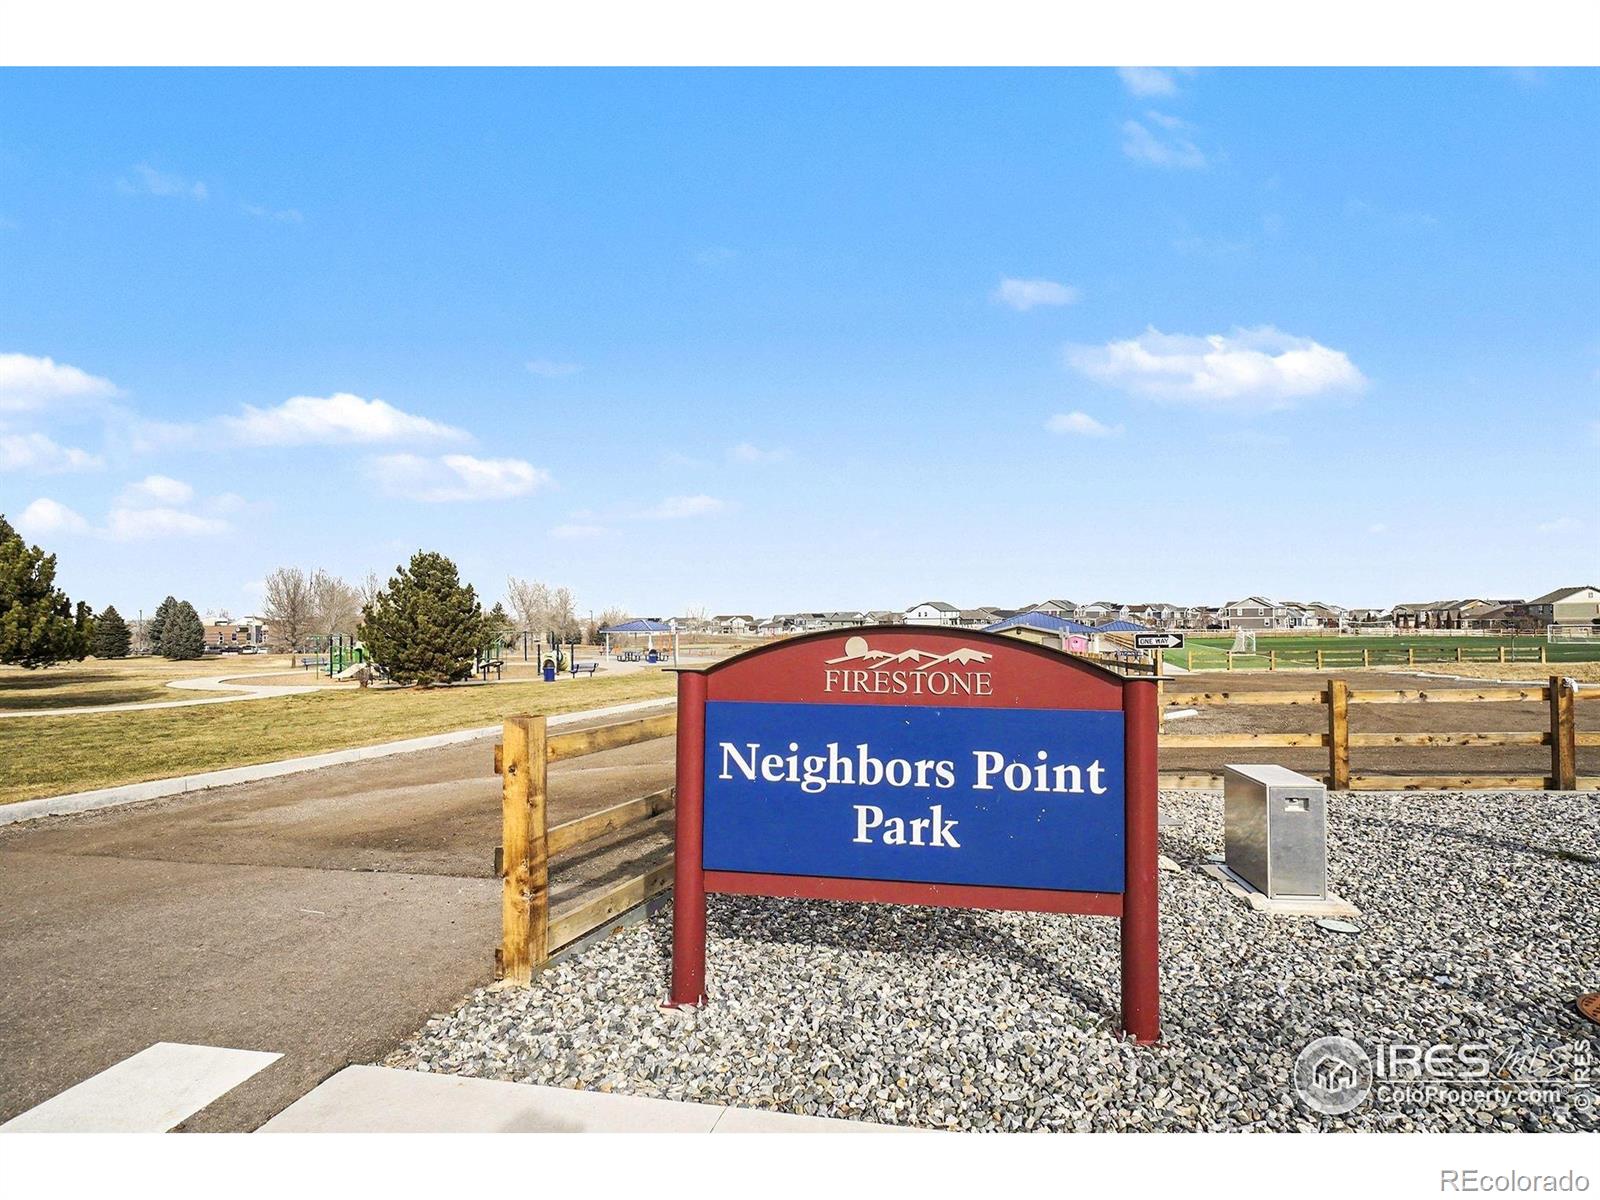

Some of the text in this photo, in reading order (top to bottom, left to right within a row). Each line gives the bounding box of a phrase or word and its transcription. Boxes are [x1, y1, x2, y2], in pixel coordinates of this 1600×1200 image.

[824, 669, 993, 696] FIRESTONE
[718, 742, 1107, 795] Neighbors Point
[852, 804, 961, 848] Park
